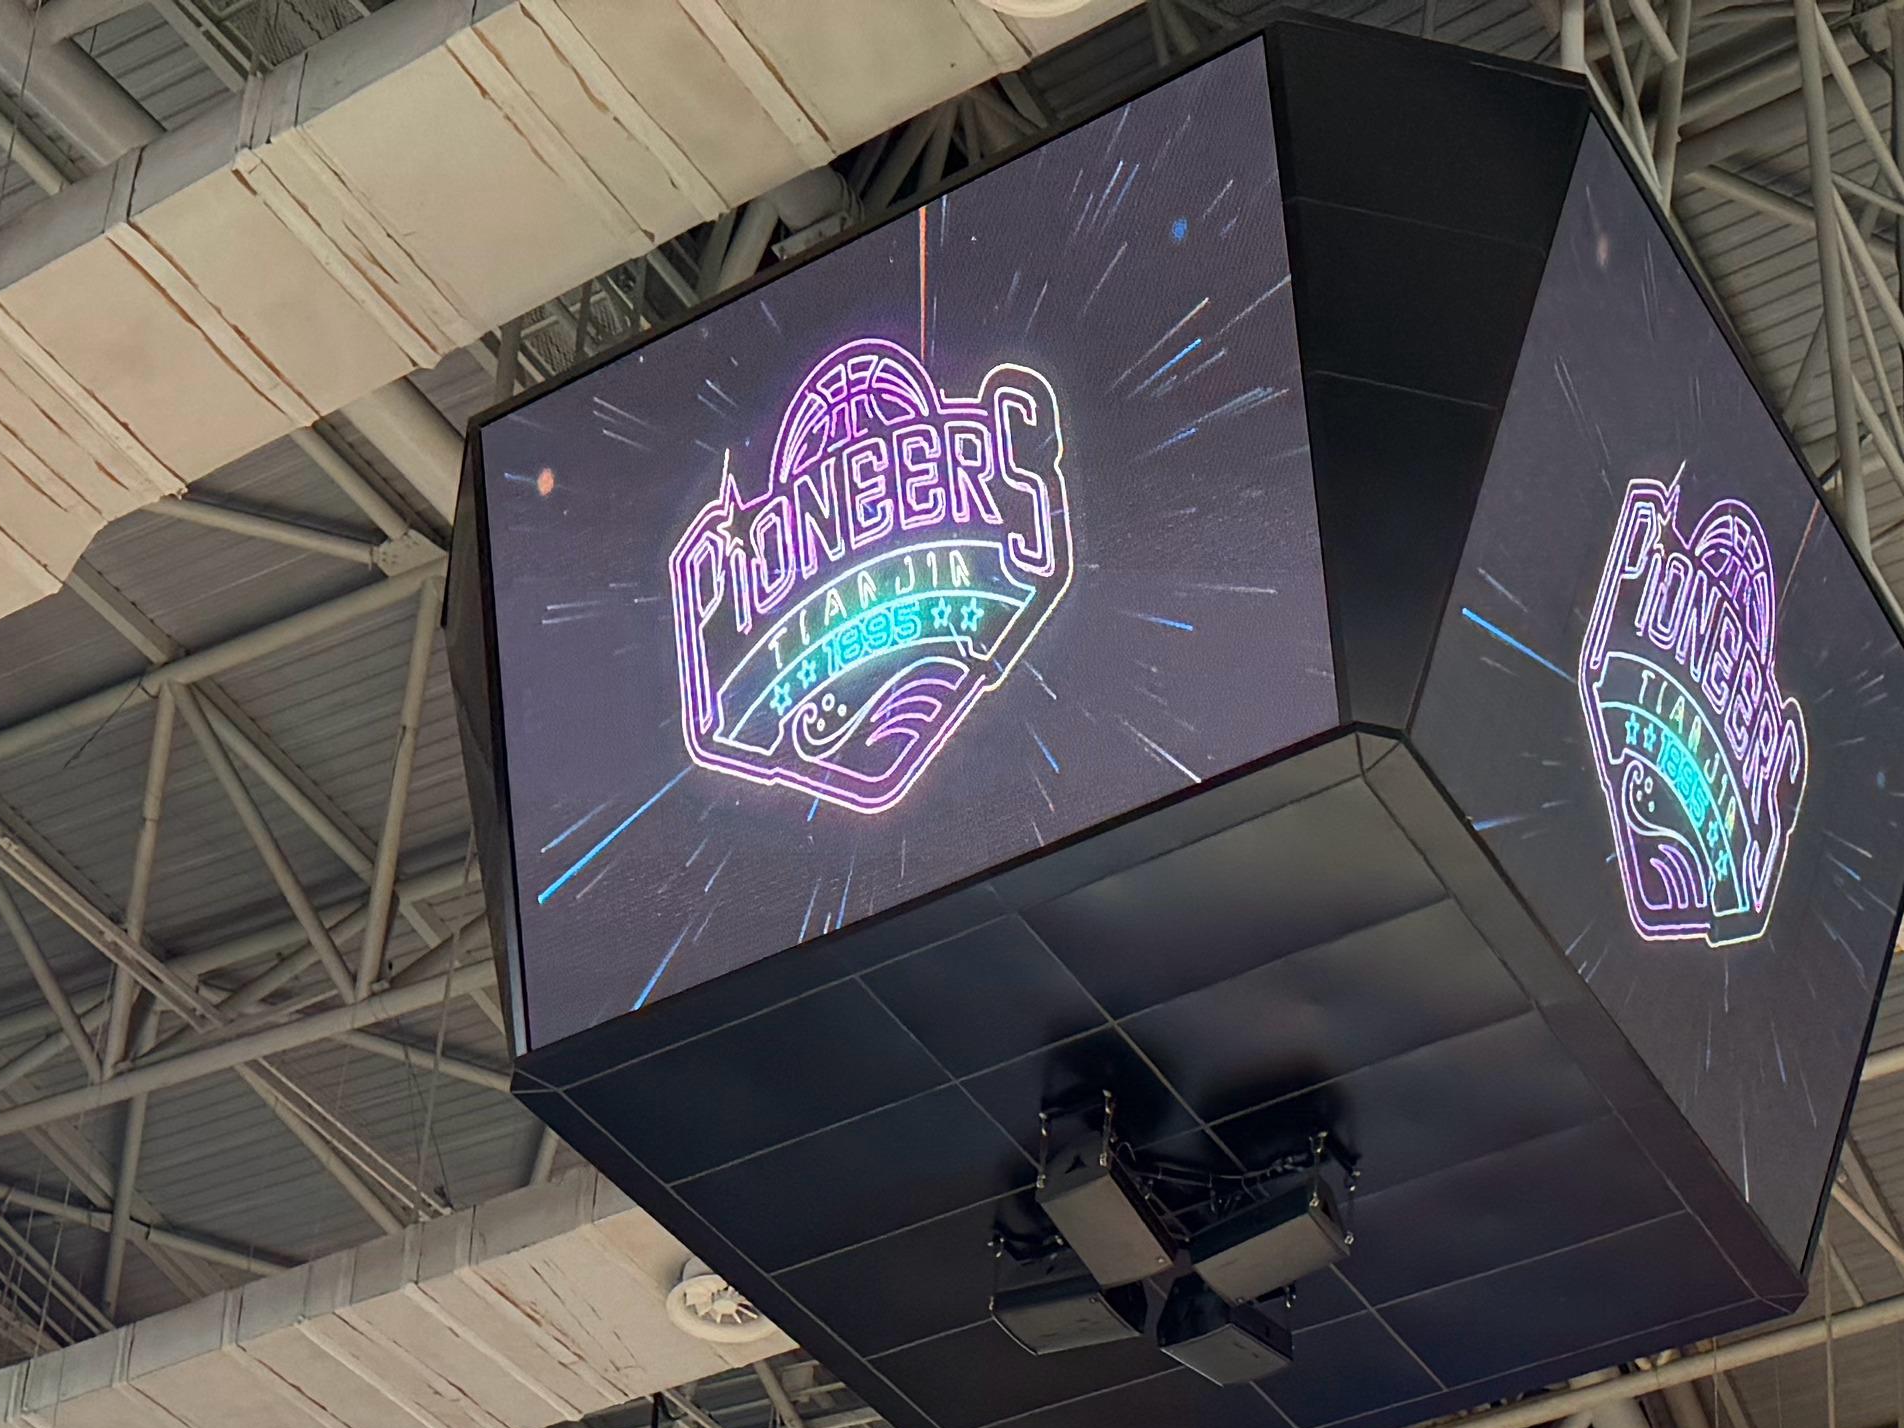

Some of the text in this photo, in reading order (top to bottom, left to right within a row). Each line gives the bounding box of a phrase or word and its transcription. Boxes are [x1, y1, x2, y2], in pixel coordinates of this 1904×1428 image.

[687, 387, 1055, 734] PIONEERS
[768, 549, 970, 670] TIANJIN
[823, 602, 925, 674] 1895
[1638, 670, 1736, 834] TIANJIN
